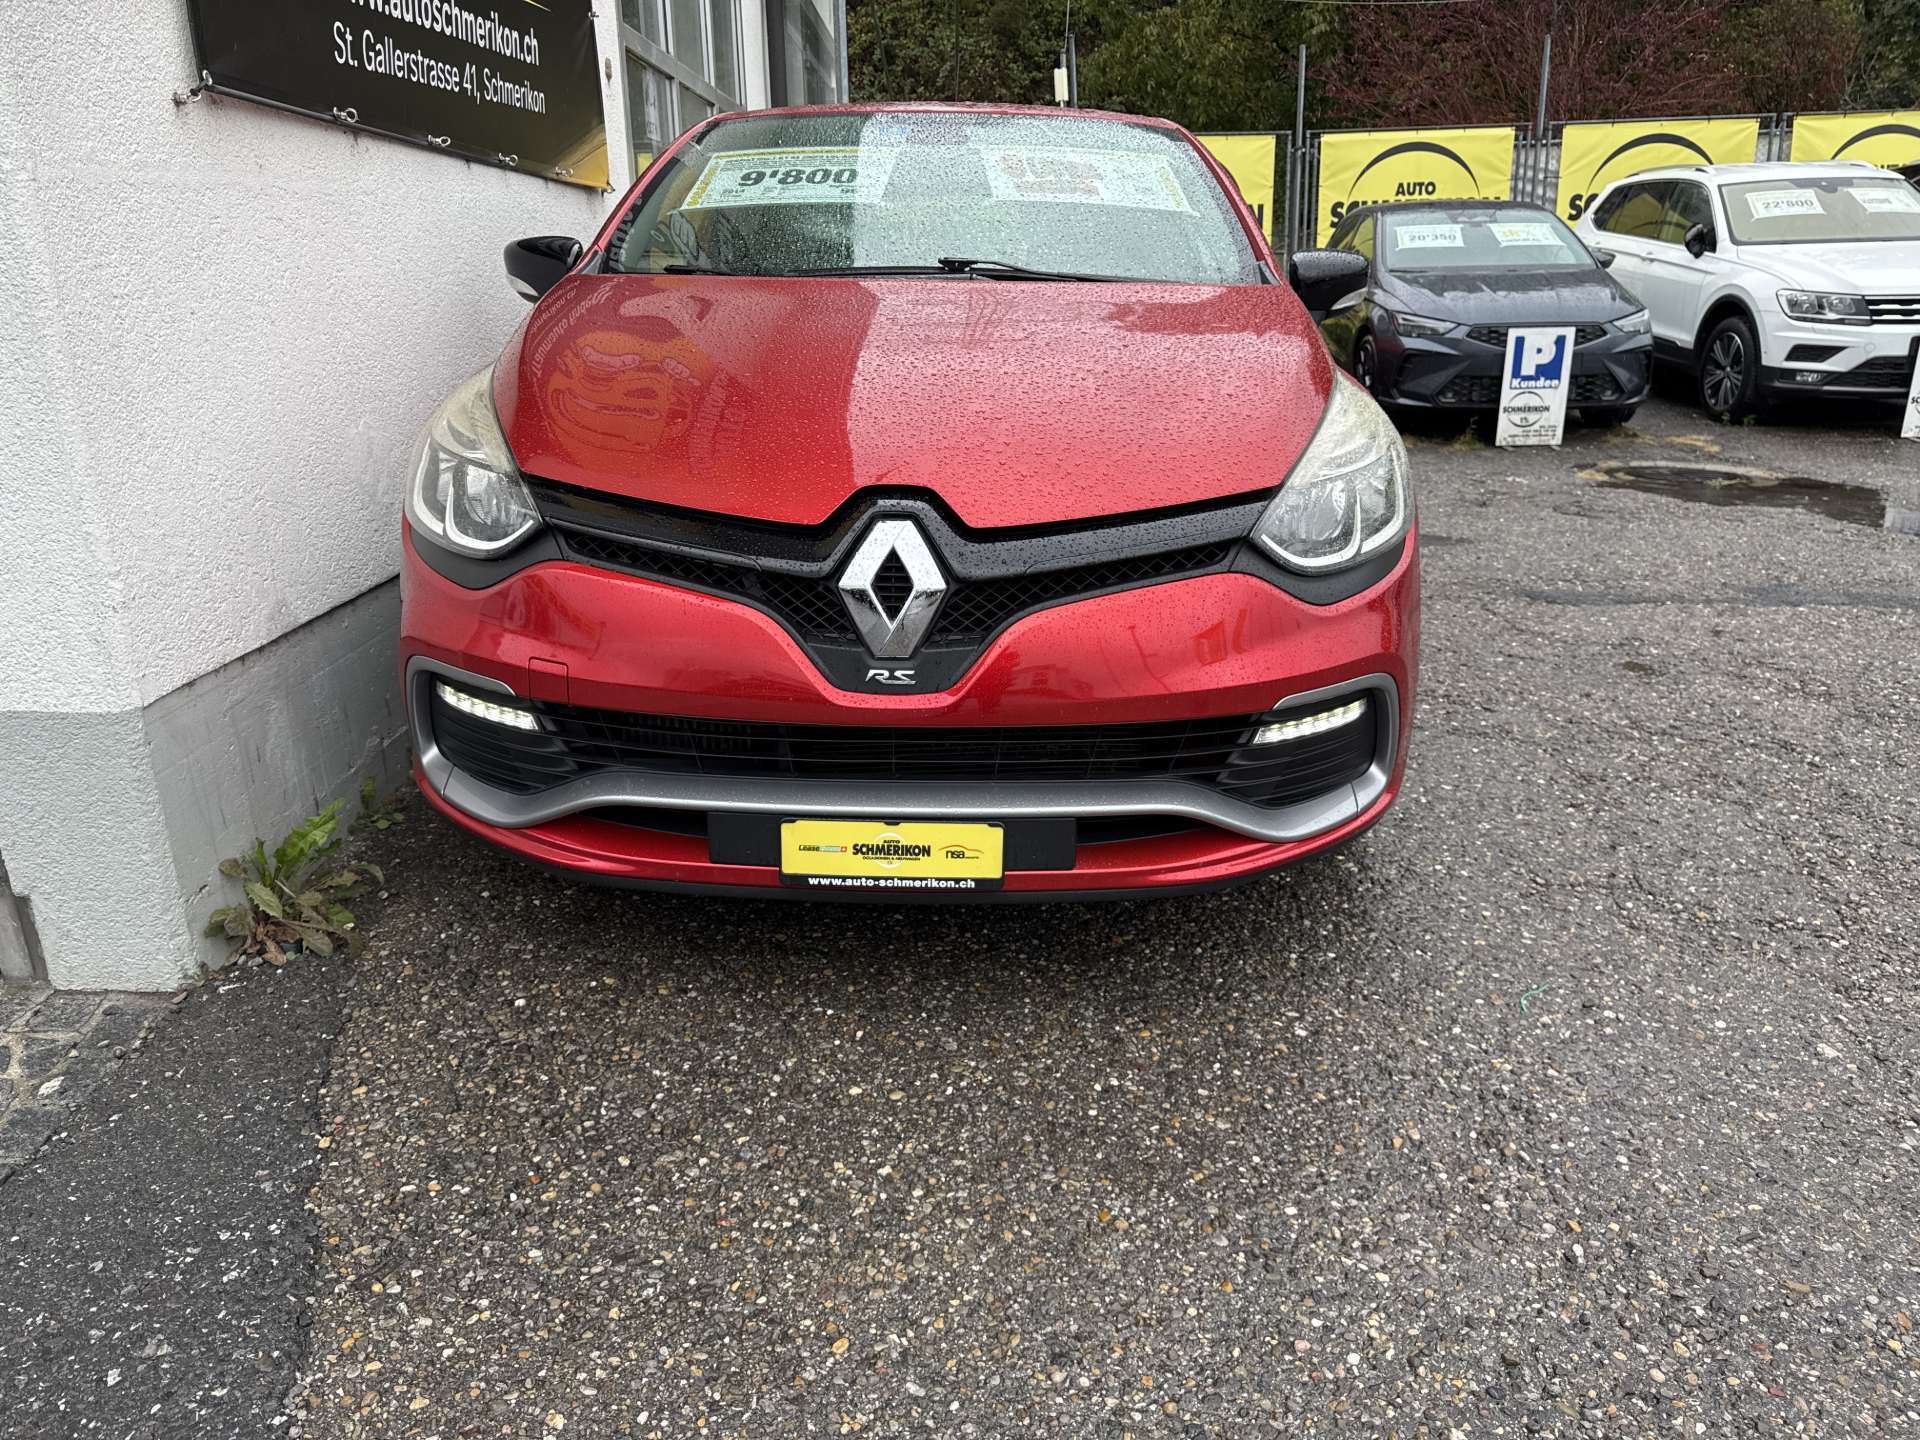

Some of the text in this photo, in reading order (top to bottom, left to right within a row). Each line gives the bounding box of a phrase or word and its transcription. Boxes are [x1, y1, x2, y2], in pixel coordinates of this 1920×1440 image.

[351, 0, 539, 66] .autoschmerikon.ch
[333, 21, 545, 114] St. Gallerstrasse 41, Schmerikon
[738, 168, 858, 186] 9'800
[1395, 181, 1436, 196] AUTO
[1520, 332, 1557, 376] P
[1511, 377, 1560, 388] Kunden
[865, 669, 916, 685] RS
[852, 843, 931, 858] SCHMERIKON
[945, 850, 965, 859] nsa
[808, 876, 975, 888] www.auto-schmerikon.ch
